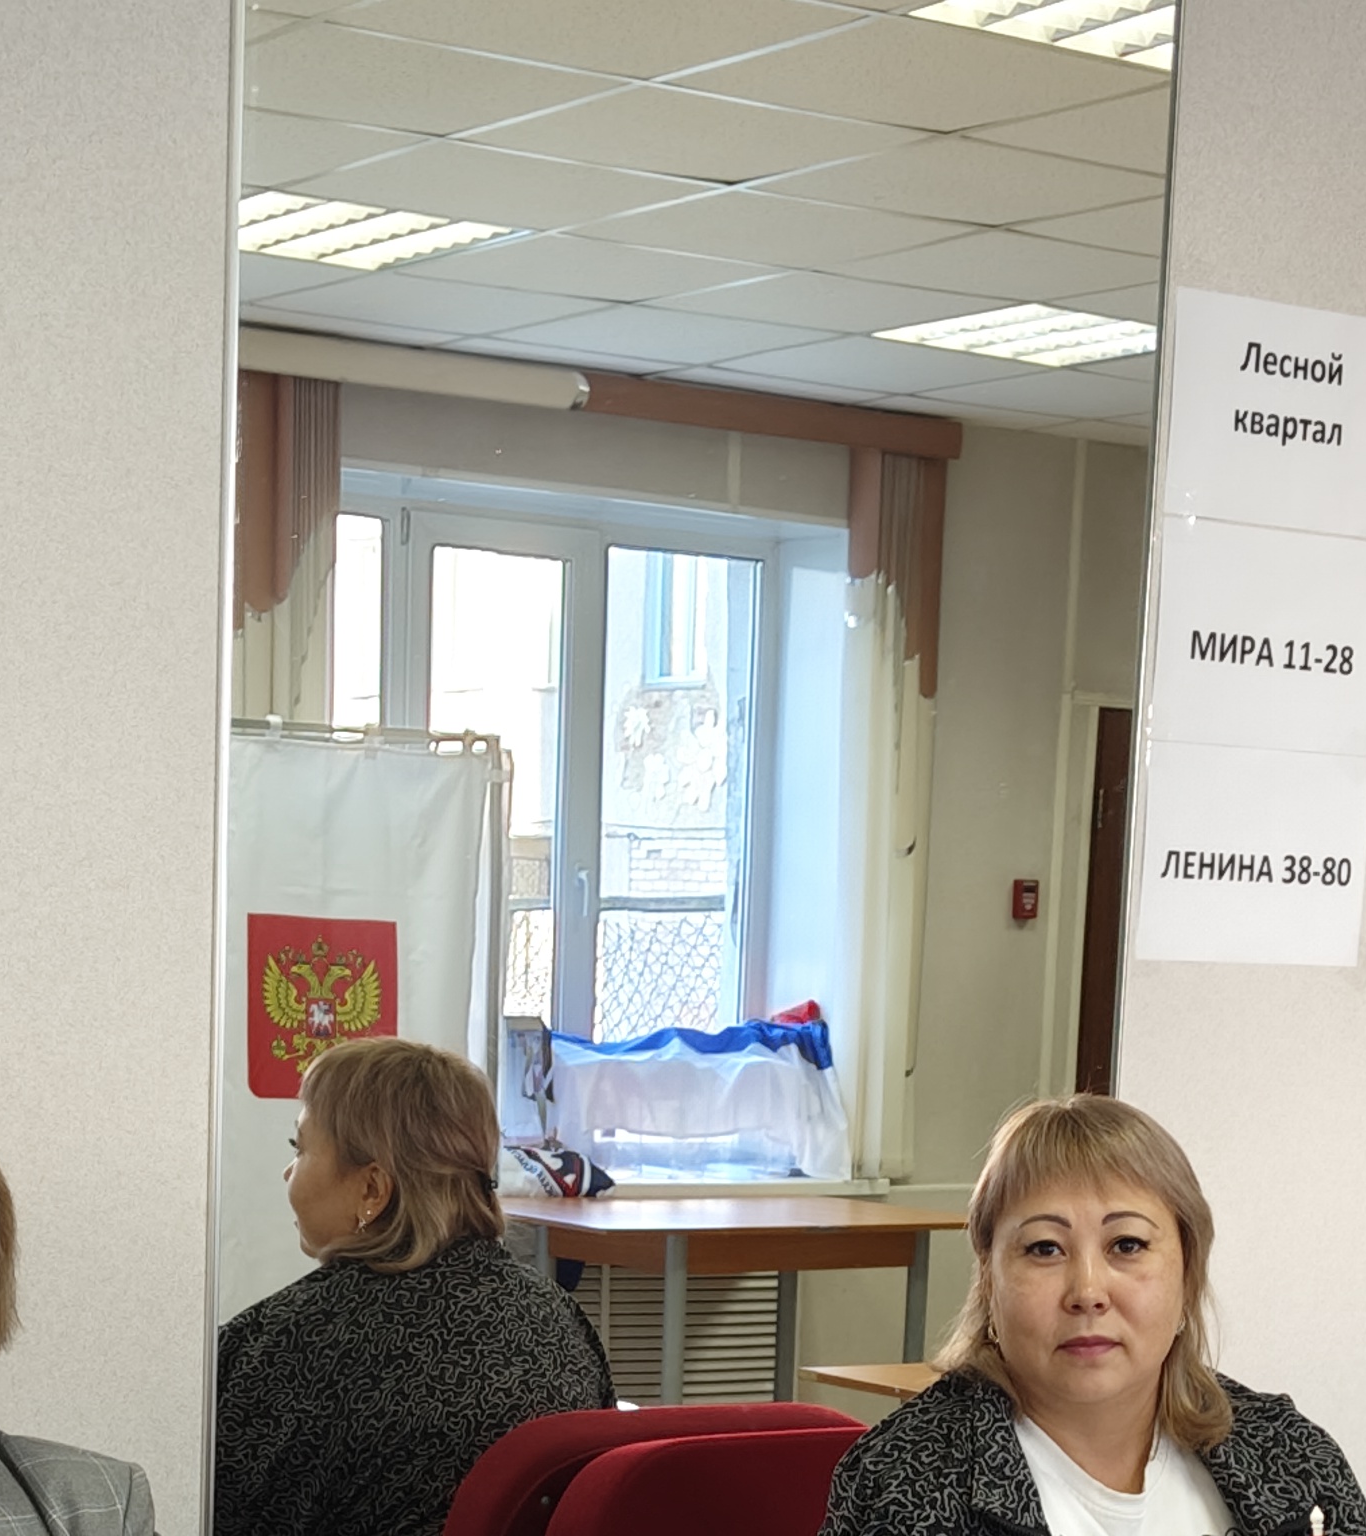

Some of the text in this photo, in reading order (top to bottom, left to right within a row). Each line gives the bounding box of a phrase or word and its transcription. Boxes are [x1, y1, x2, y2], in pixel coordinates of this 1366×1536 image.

[1239, 341, 1344, 386] Лесной
[1234, 408, 1343, 447] квартал
[1190, 630, 1355, 676] МИРА 11-28
[1161, 850, 1353, 887] ЛЕНИНА 38-80
